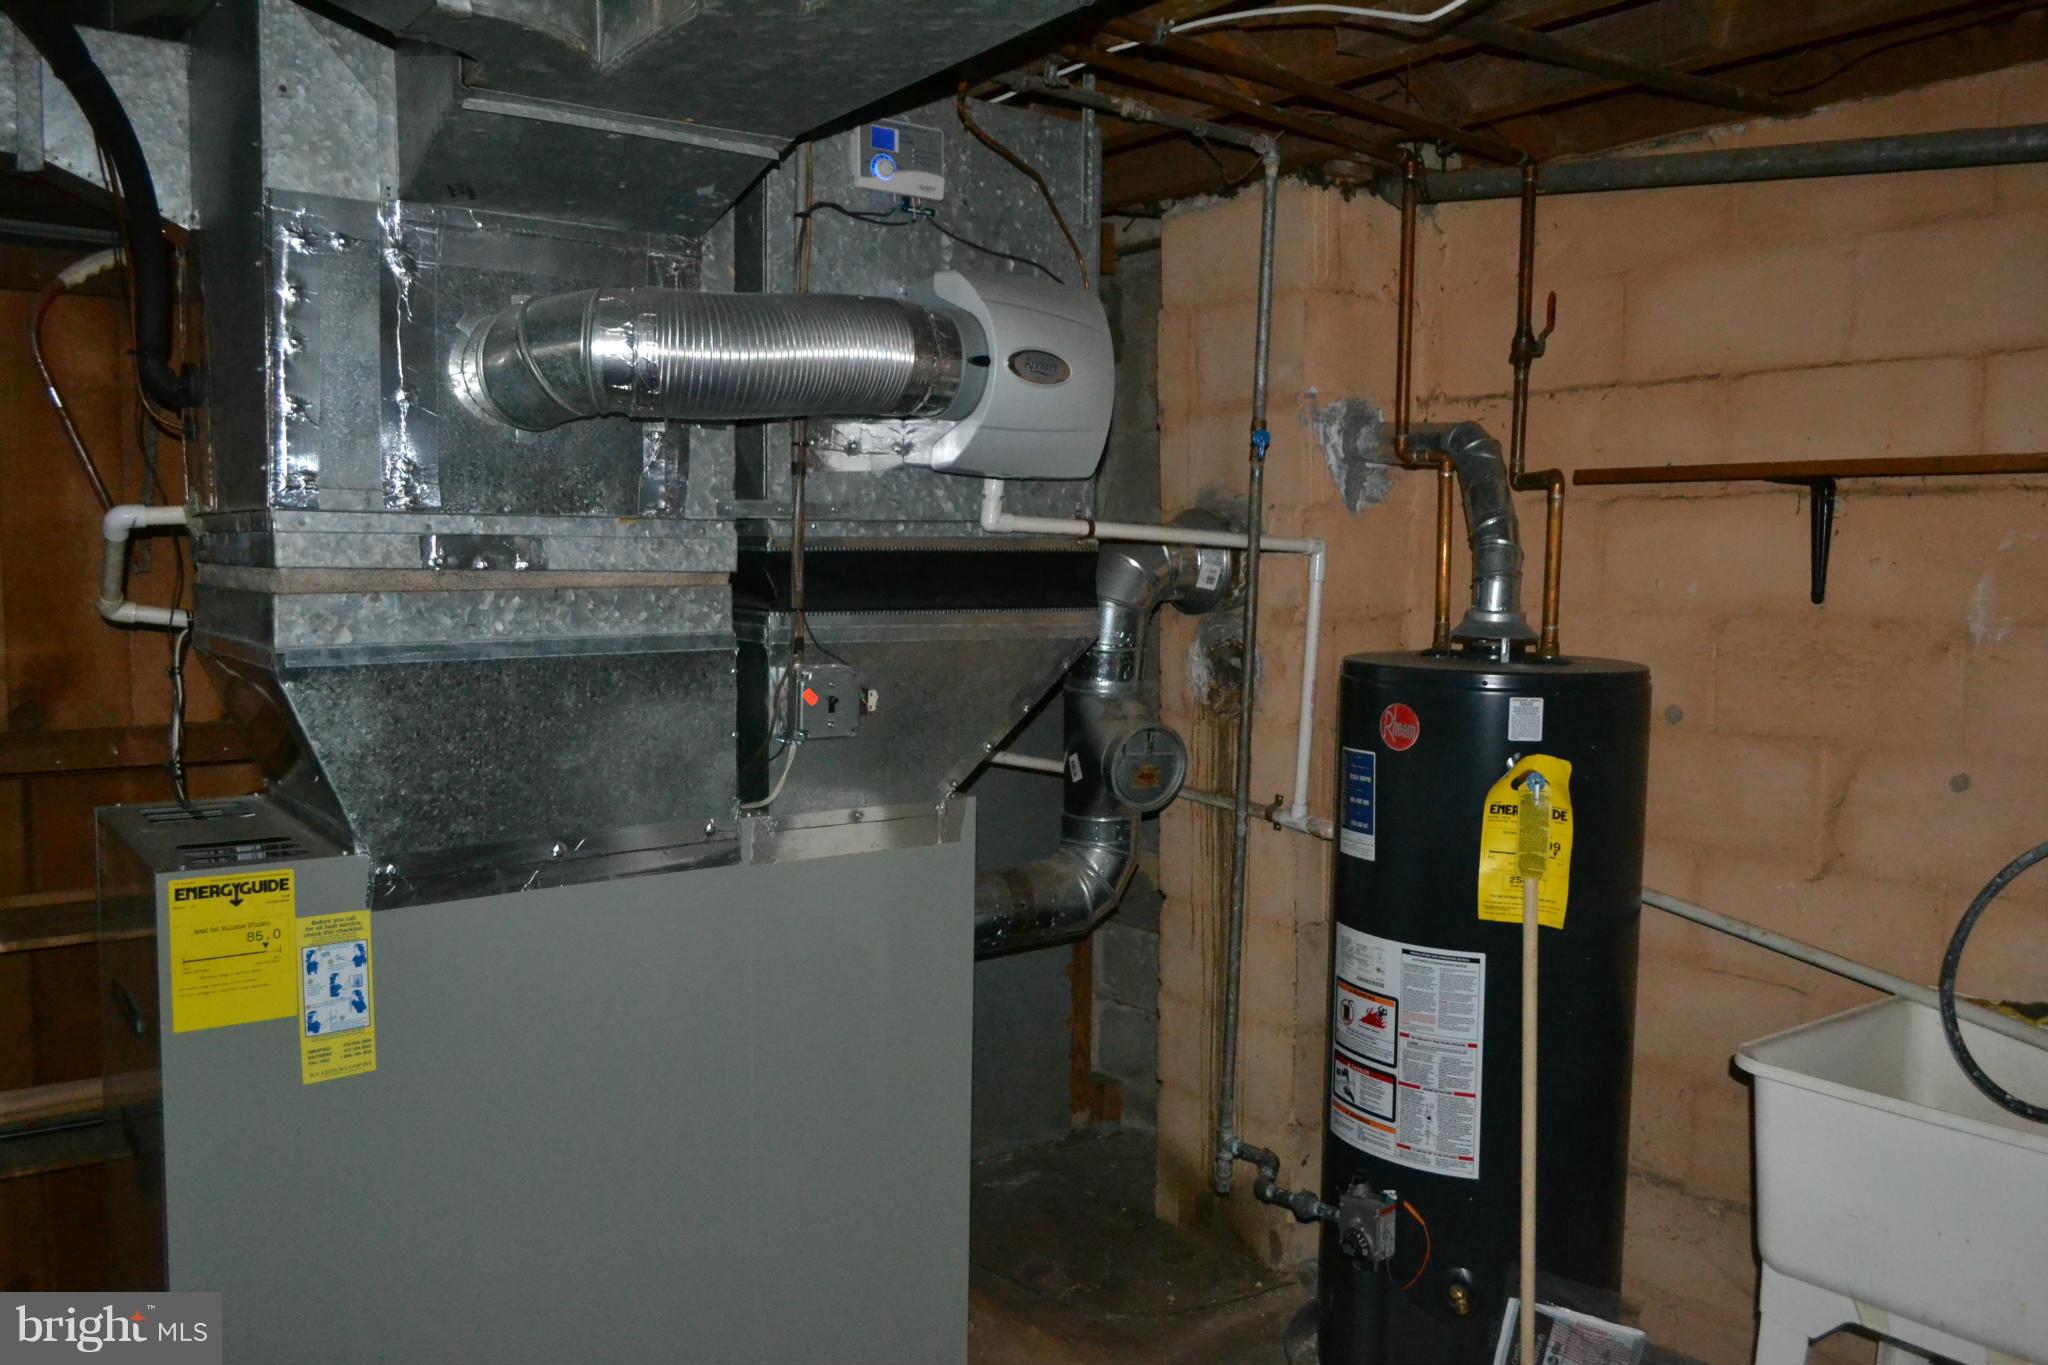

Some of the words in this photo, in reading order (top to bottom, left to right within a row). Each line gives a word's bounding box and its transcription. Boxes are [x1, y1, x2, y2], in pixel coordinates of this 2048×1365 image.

[1384, 705, 1417, 743] Rheem
[174, 877, 290, 904] ENERGYGUIDE
[246, 928, 281, 943] 85.0
